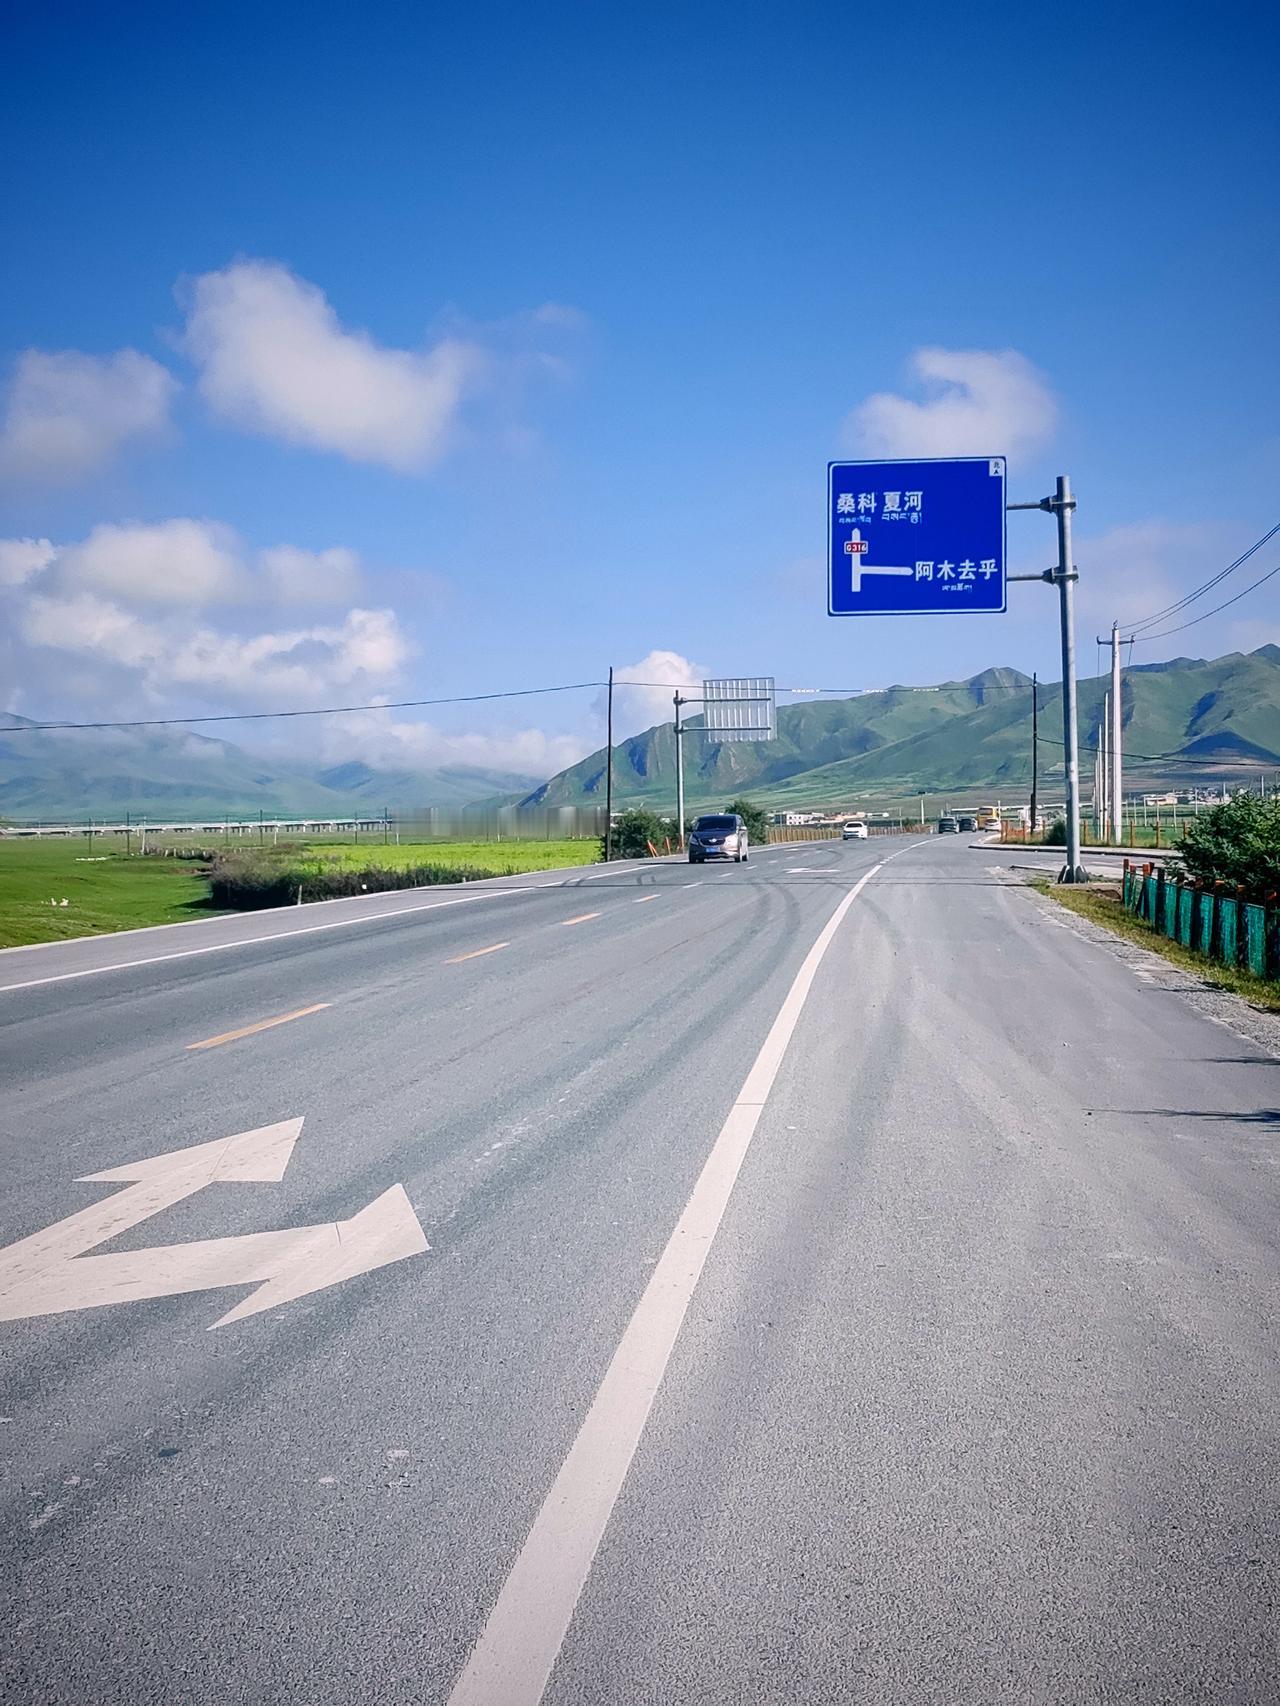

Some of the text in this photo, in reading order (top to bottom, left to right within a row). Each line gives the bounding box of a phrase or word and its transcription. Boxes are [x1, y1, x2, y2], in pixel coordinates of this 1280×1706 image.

[837, 491, 923, 514] 桑科 夏河
[846, 543, 867, 552] G316
[915, 558, 998, 581] 阿木去乎
